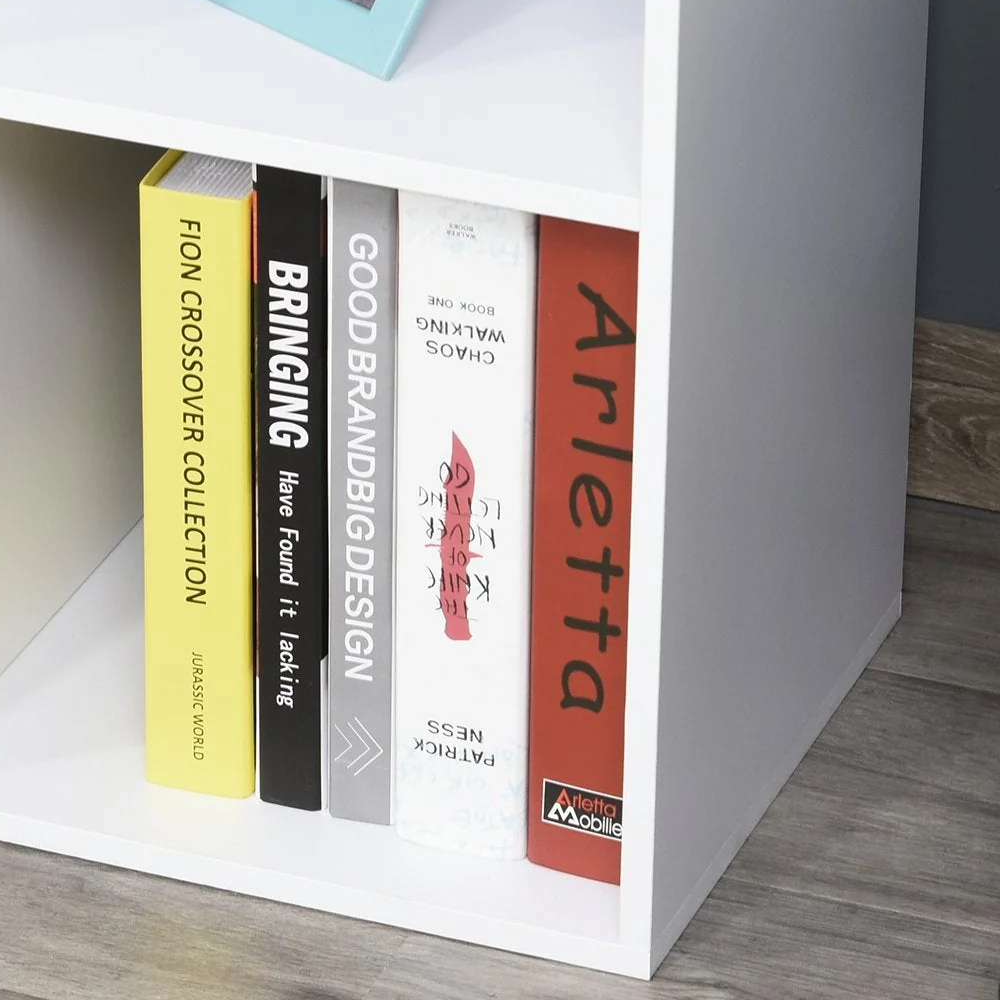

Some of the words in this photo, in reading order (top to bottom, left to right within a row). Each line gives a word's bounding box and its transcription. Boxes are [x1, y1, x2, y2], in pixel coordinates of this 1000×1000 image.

[179, 218, 202, 282] FION
[427, 294, 454, 309] ONE
[459, 301, 495, 317] BOOK
[415, 316, 505, 344] WALKING
[425, 339, 495, 365] CHAOS
[180, 289, 205, 443] CROSSOVER
[268, 259, 309, 450] BRINGING
[278, 470, 300, 518] Have
[439, 461, 471, 489] GO
[560, 281, 637, 714] Arletta
[183, 450, 207, 605] COLLECTION
[279, 527, 300, 587] Found
[279, 598, 300, 619] it
[191, 651, 207, 711] JURASSIC
[276, 631, 300, 709] lacking
[192, 713, 206, 761] WORLD
[413, 736, 496, 767] PATRICK
[427, 719, 484, 744] NESS
[556, 787, 617, 818] Arletta
